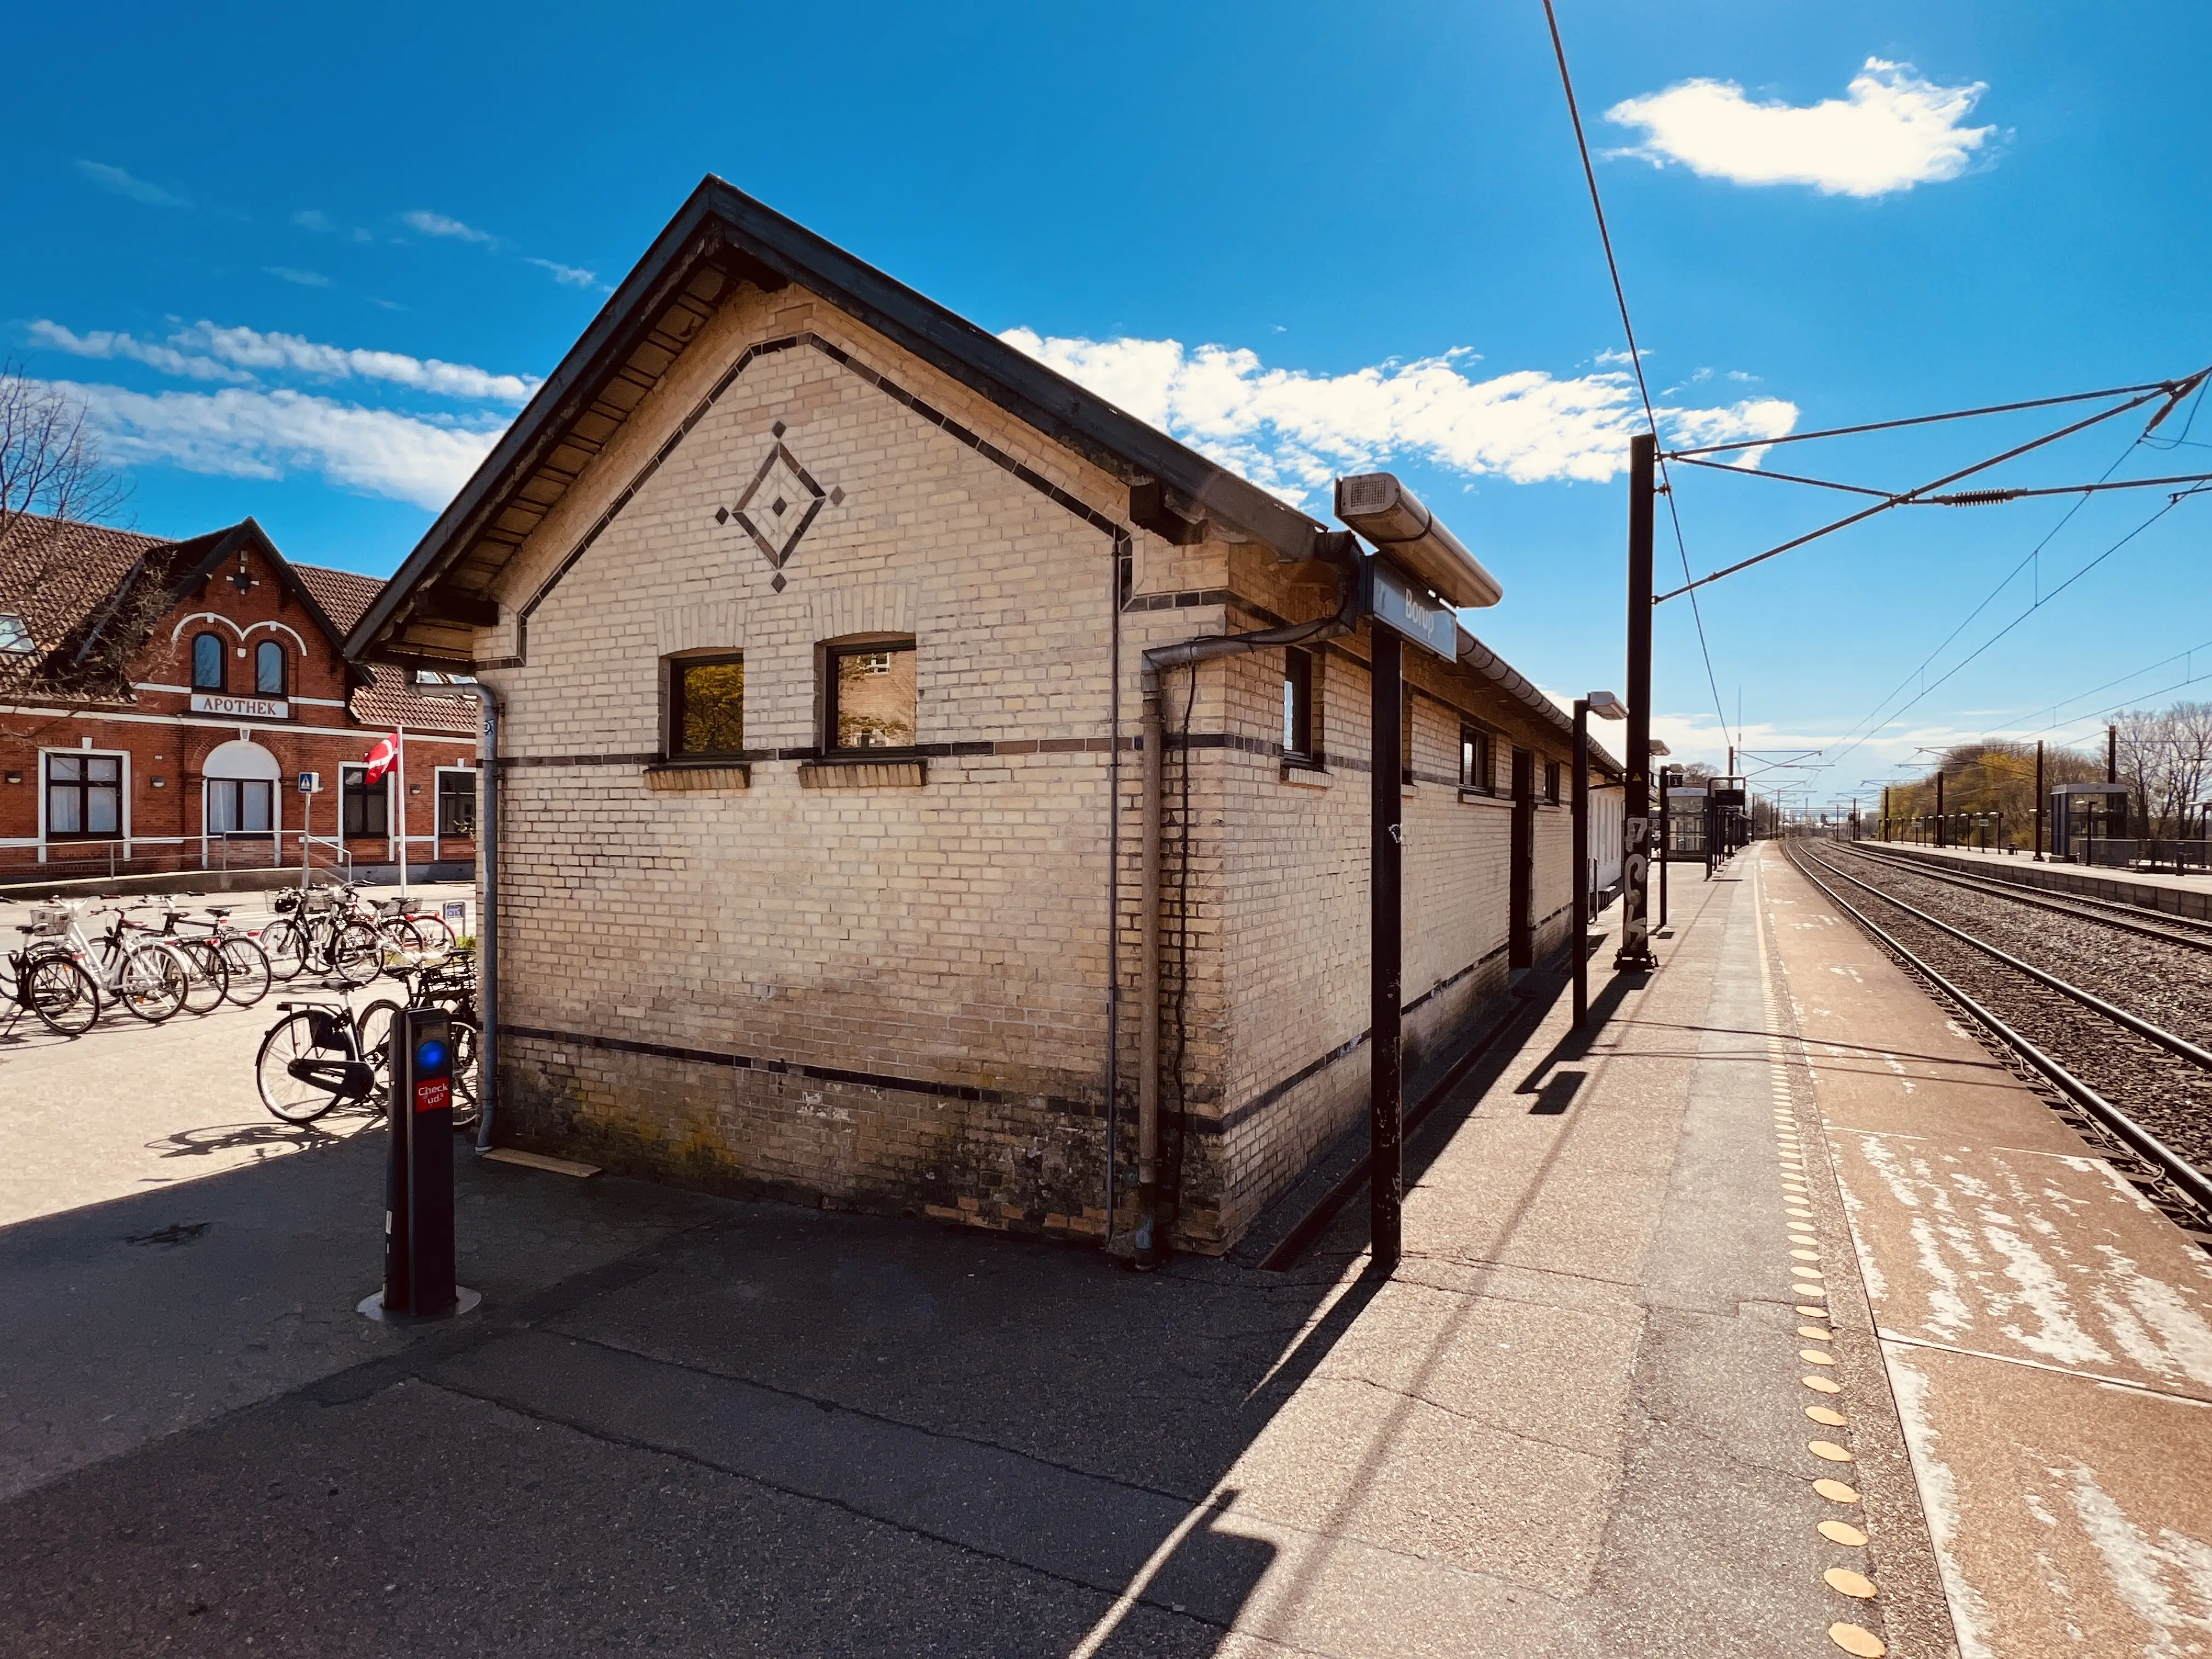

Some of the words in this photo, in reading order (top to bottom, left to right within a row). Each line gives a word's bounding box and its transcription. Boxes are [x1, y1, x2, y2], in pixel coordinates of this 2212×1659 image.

[1406, 588, 1434, 640] Borup
[204, 697, 276, 715] APOTHEK
[418, 1083, 448, 1096] Check
